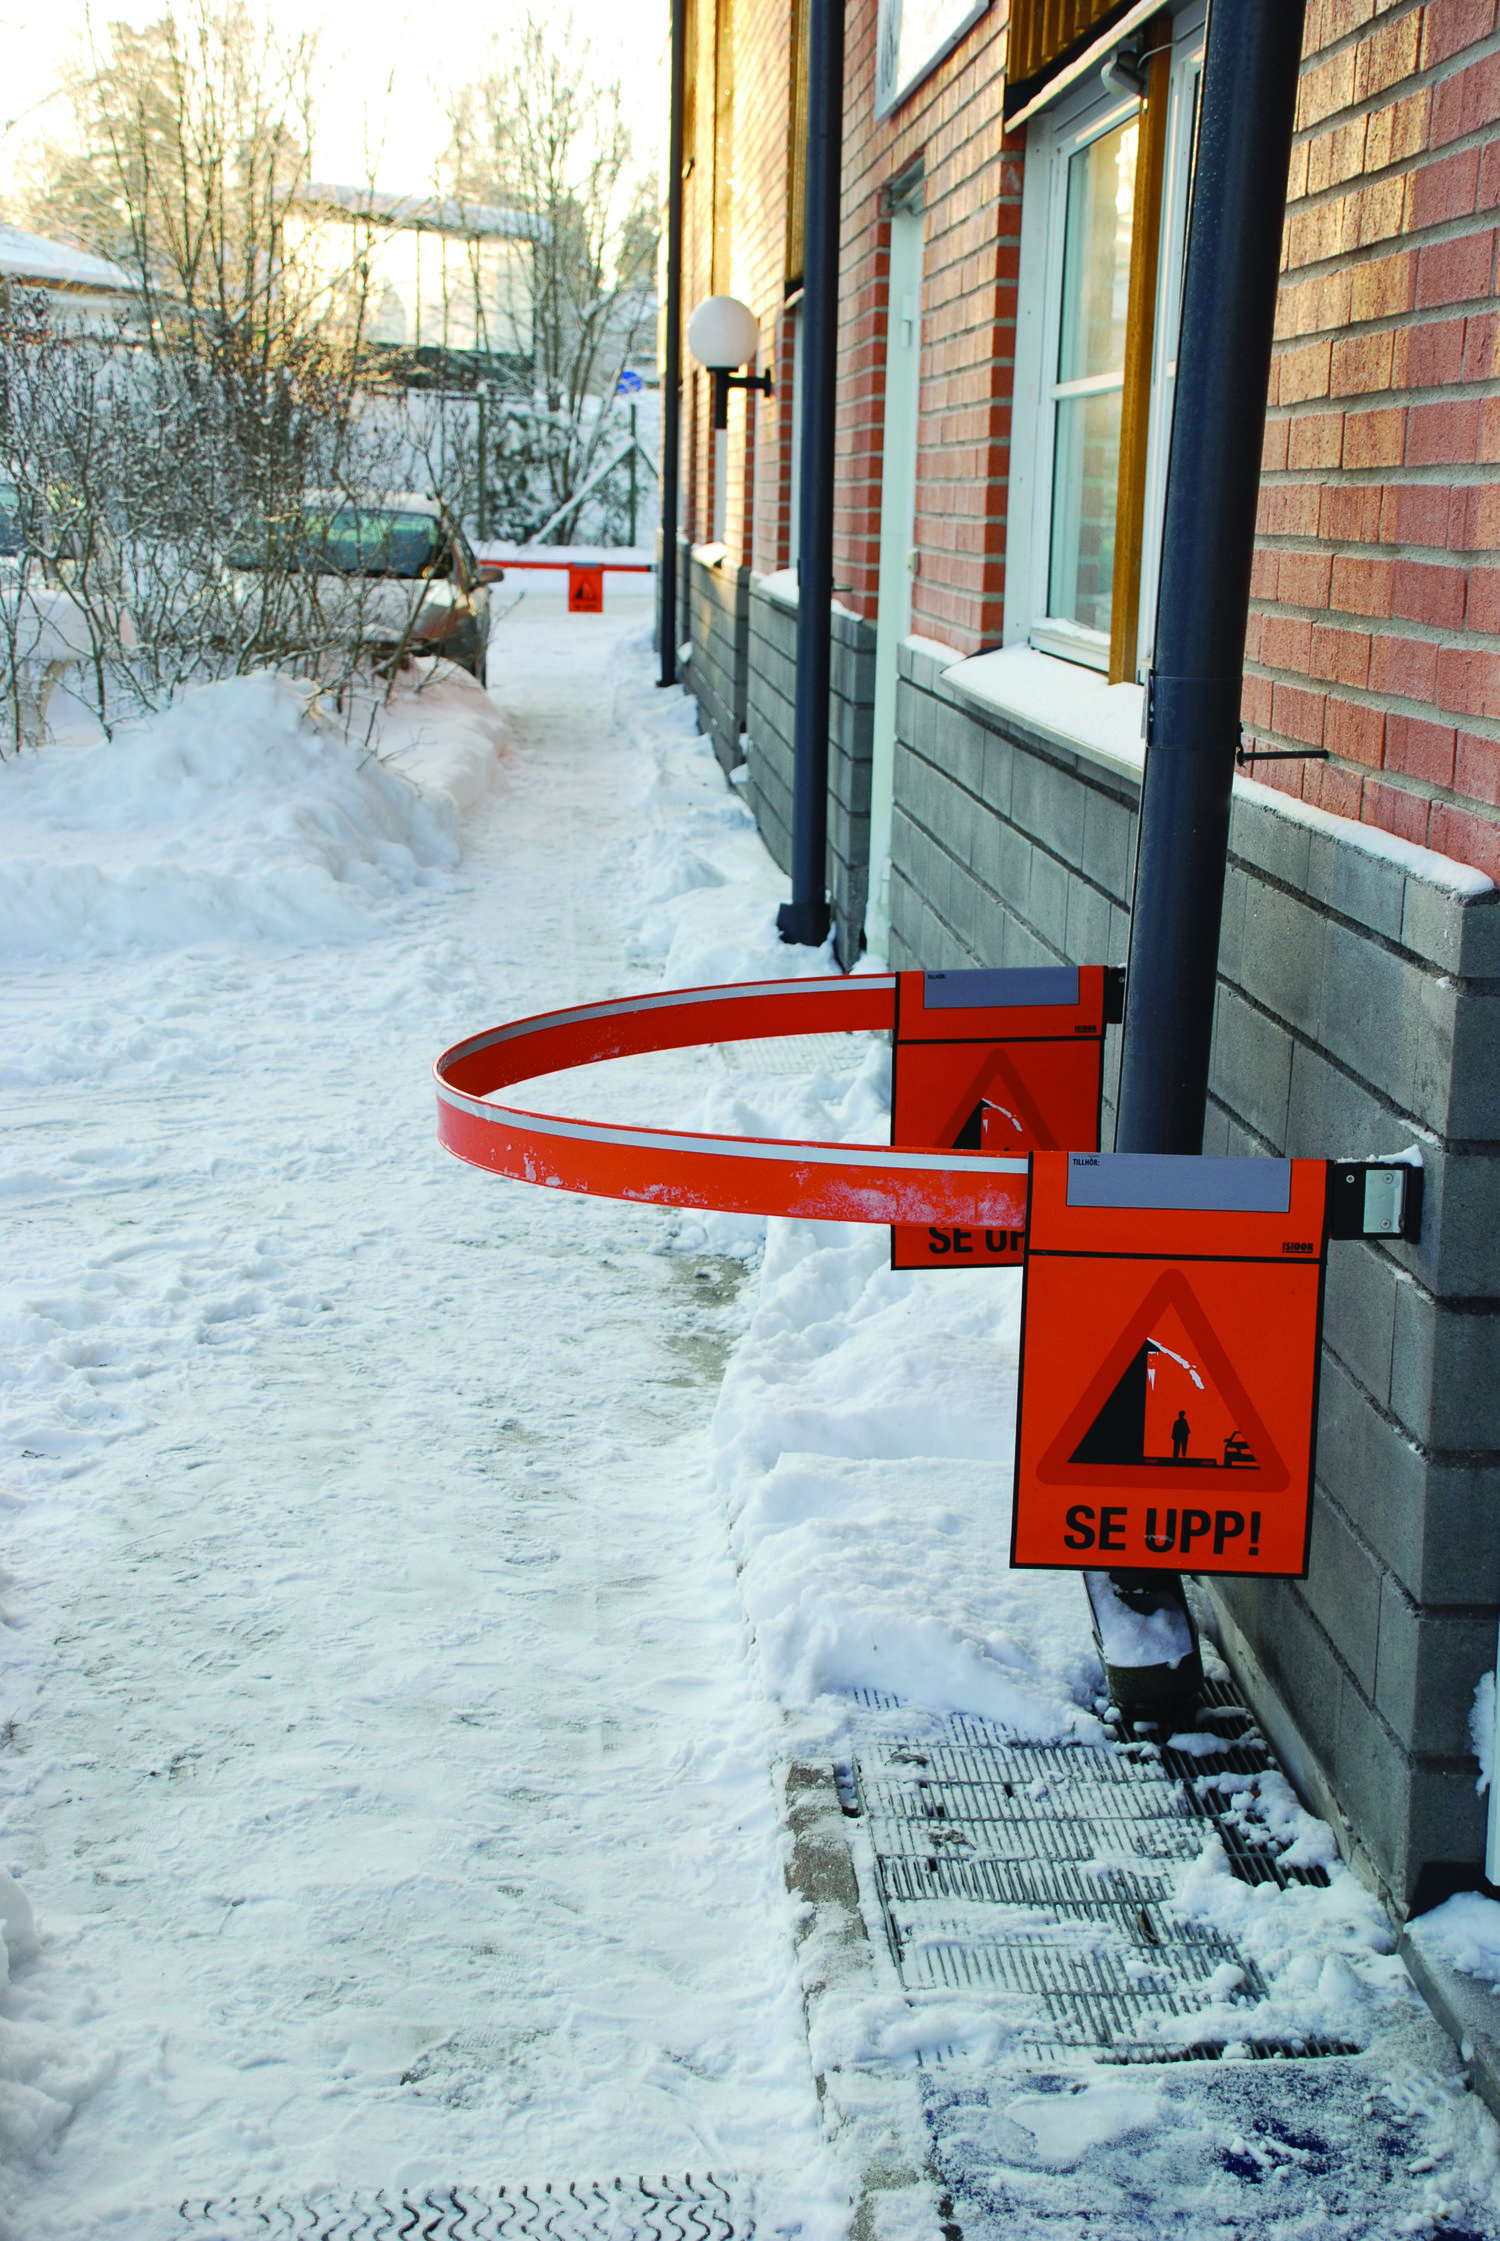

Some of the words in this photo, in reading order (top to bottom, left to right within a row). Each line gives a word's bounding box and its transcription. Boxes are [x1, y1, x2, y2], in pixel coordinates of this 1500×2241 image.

[1072, 1158, 1100, 1167] TILLHÖR:
[929, 1226, 973, 1254] SE
[985, 1229, 1025, 1253] UP
[1282, 1241, 1314, 1254] ISIDOR
[1064, 1505, 1127, 1550] SE
[1144, 1507, 1261, 1556] UPP!
